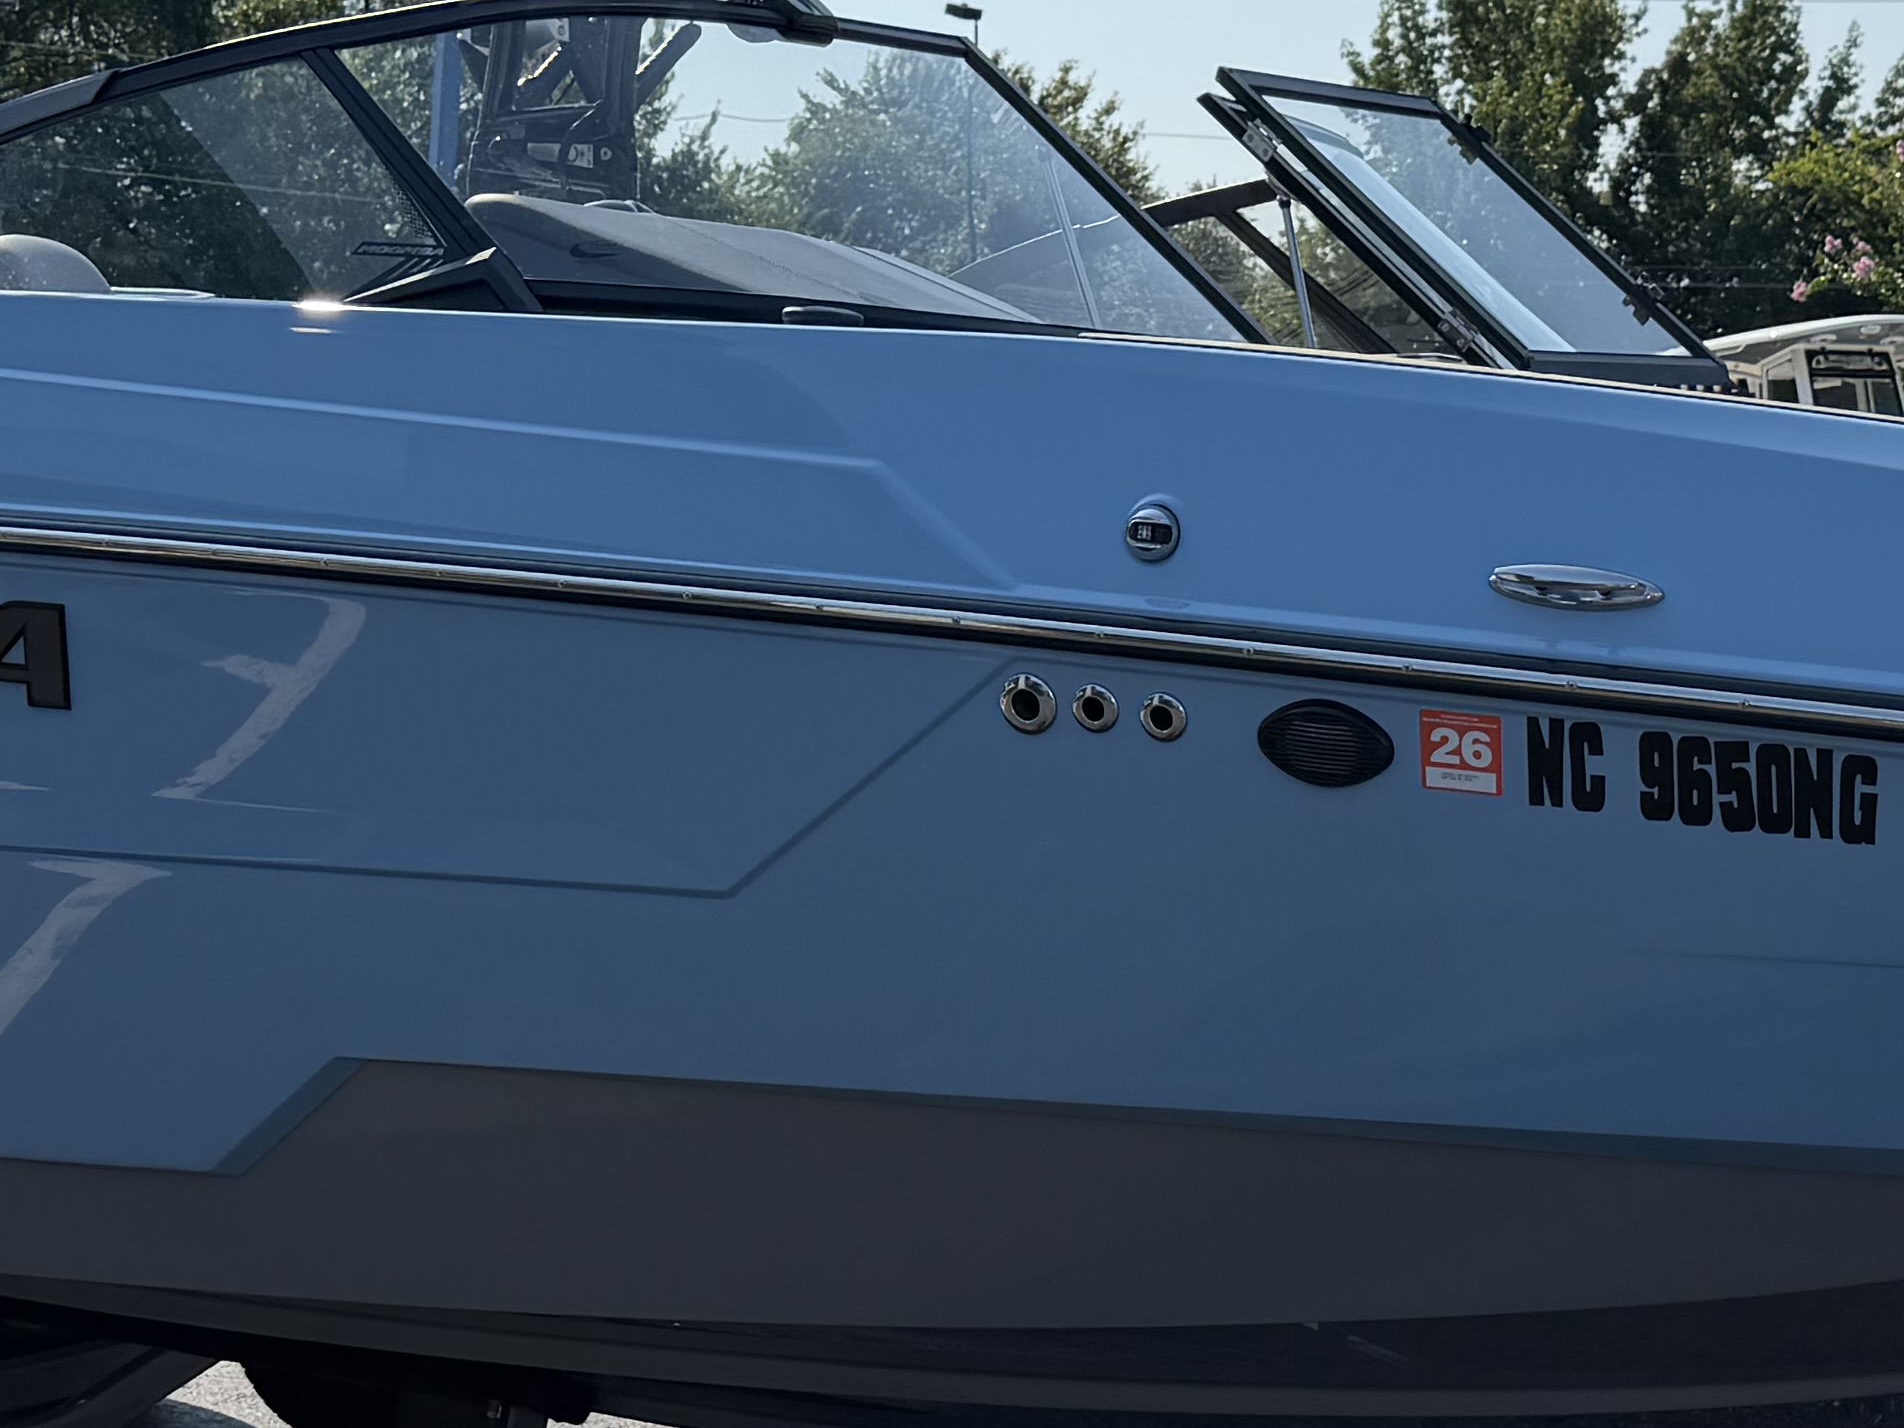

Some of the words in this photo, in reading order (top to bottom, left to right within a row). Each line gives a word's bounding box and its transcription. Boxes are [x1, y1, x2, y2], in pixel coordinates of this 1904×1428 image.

[1430, 727, 1493, 768] 26
[1527, 716, 1606, 812] NC
[1639, 731, 1878, 845] 9650NG
